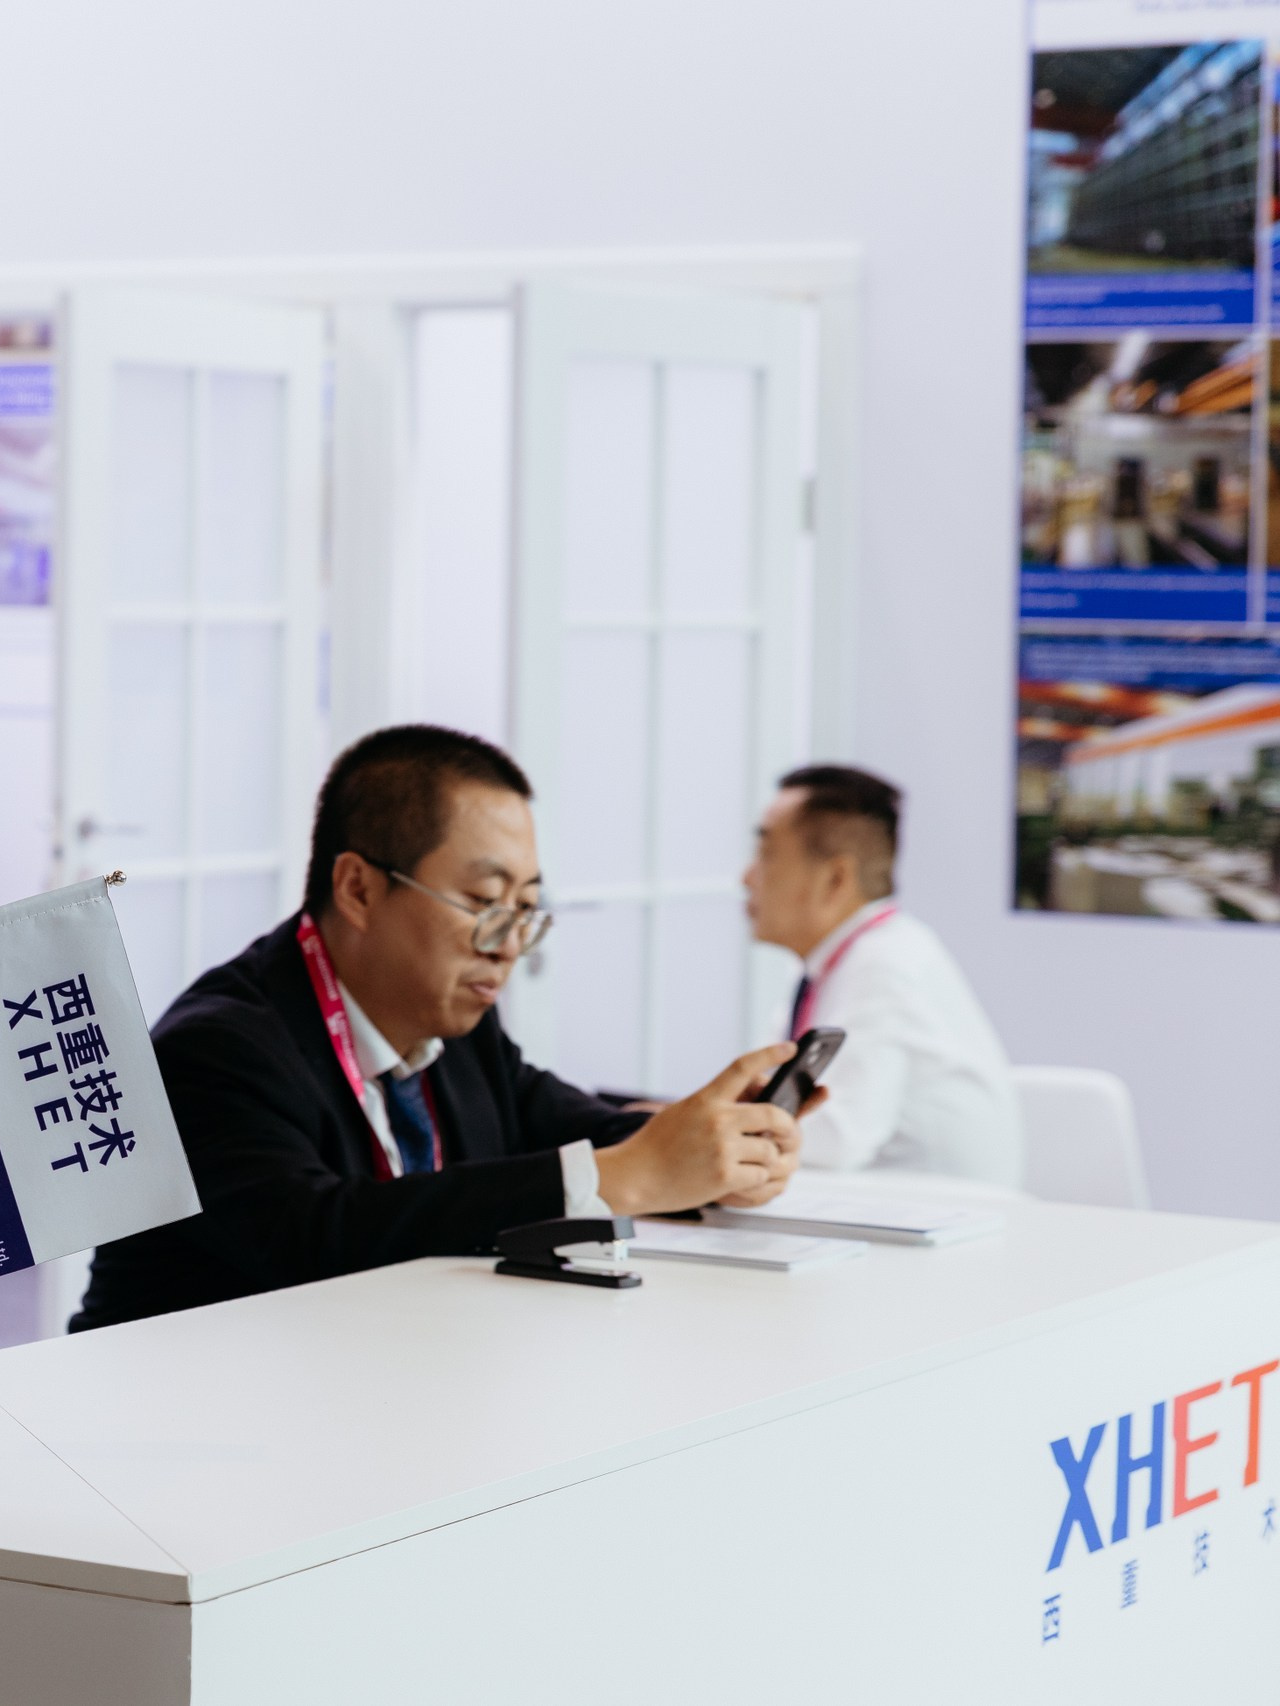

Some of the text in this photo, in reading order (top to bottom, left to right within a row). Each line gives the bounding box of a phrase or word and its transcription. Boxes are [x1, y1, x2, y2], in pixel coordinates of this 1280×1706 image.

[2, 989, 89, 1173] XHET
[41, 973, 136, 1166] 西重技术
[1046, 1358, 1280, 1573] XHET
